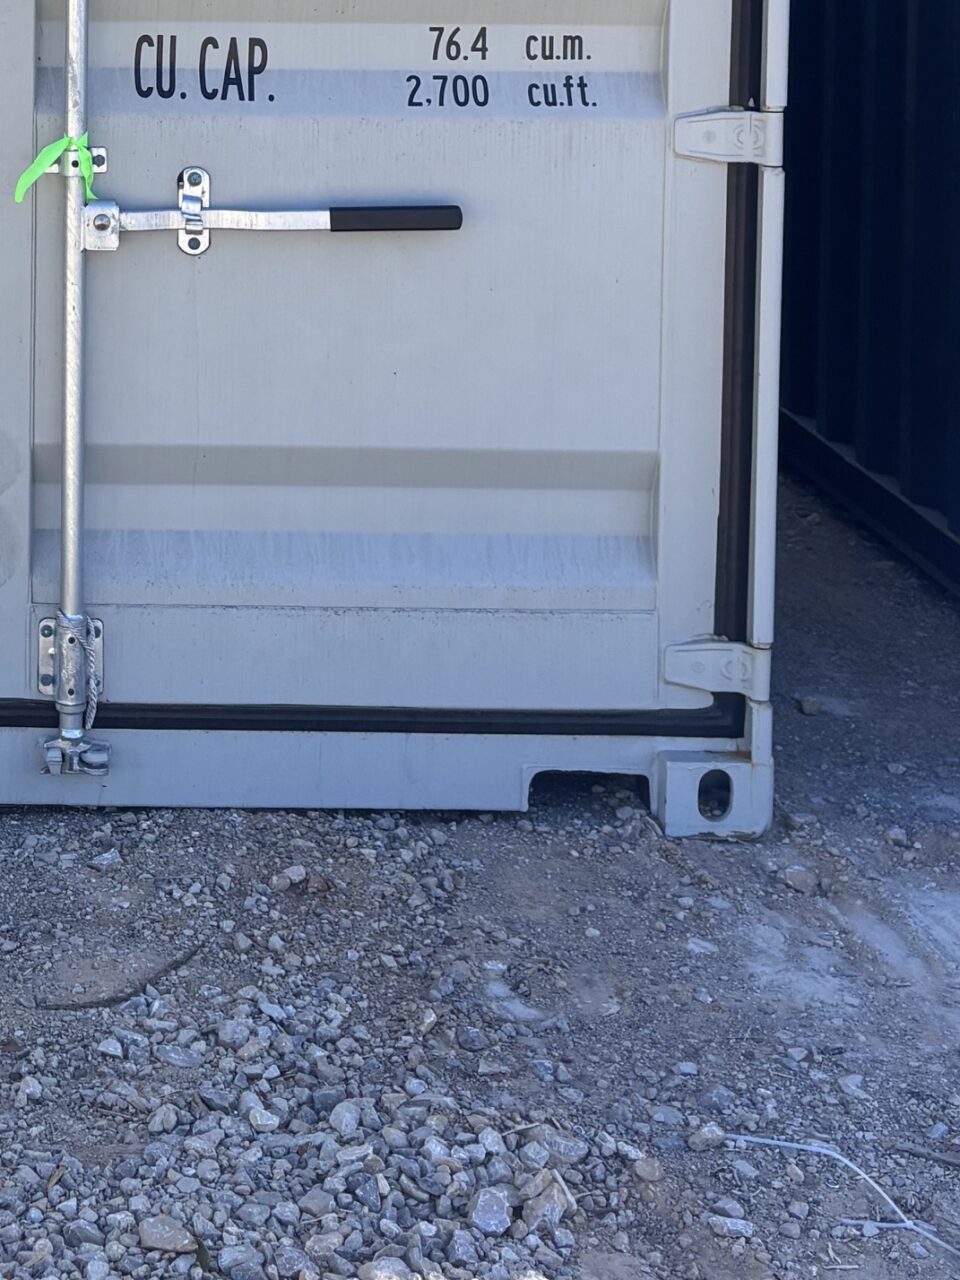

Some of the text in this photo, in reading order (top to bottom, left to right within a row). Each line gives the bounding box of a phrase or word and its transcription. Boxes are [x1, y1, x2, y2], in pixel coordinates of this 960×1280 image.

[429, 26, 592, 61] 76.4 cu.m.
[134, 34, 275, 102] CU. CAP.
[405, 74, 597, 107] 2,700 cu.ft.
